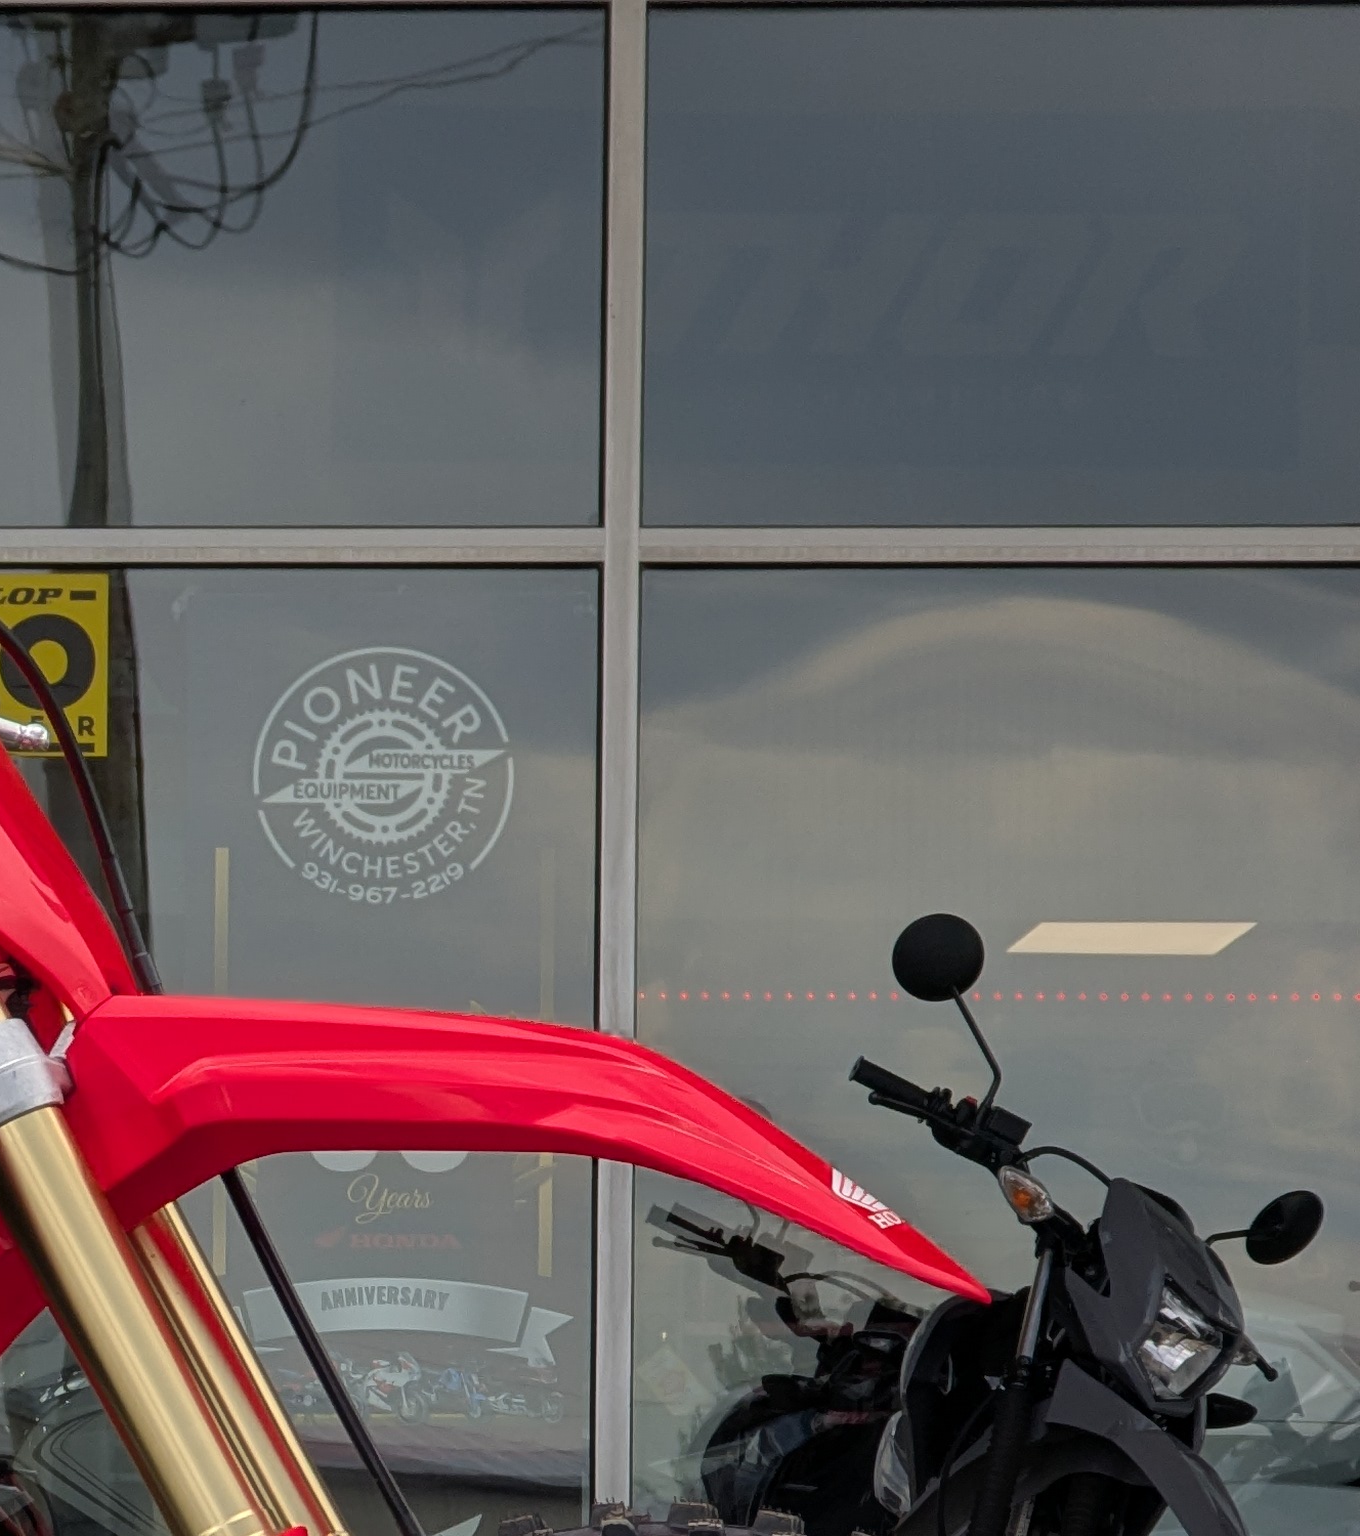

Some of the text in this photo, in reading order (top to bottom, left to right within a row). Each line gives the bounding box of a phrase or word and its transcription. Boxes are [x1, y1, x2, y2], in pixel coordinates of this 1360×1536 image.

[271, 664, 481, 771] PIONEER
[368, 752, 475, 770] MOTORCYCLES
[293, 781, 401, 800] EQUIPMENT
[301, 861, 465, 904] 931-967-2219
[346, 1173, 434, 1224] Years
[350, 1233, 461, 1249] HONDA
[320, 1286, 450, 1312] ANNIVERSARY
